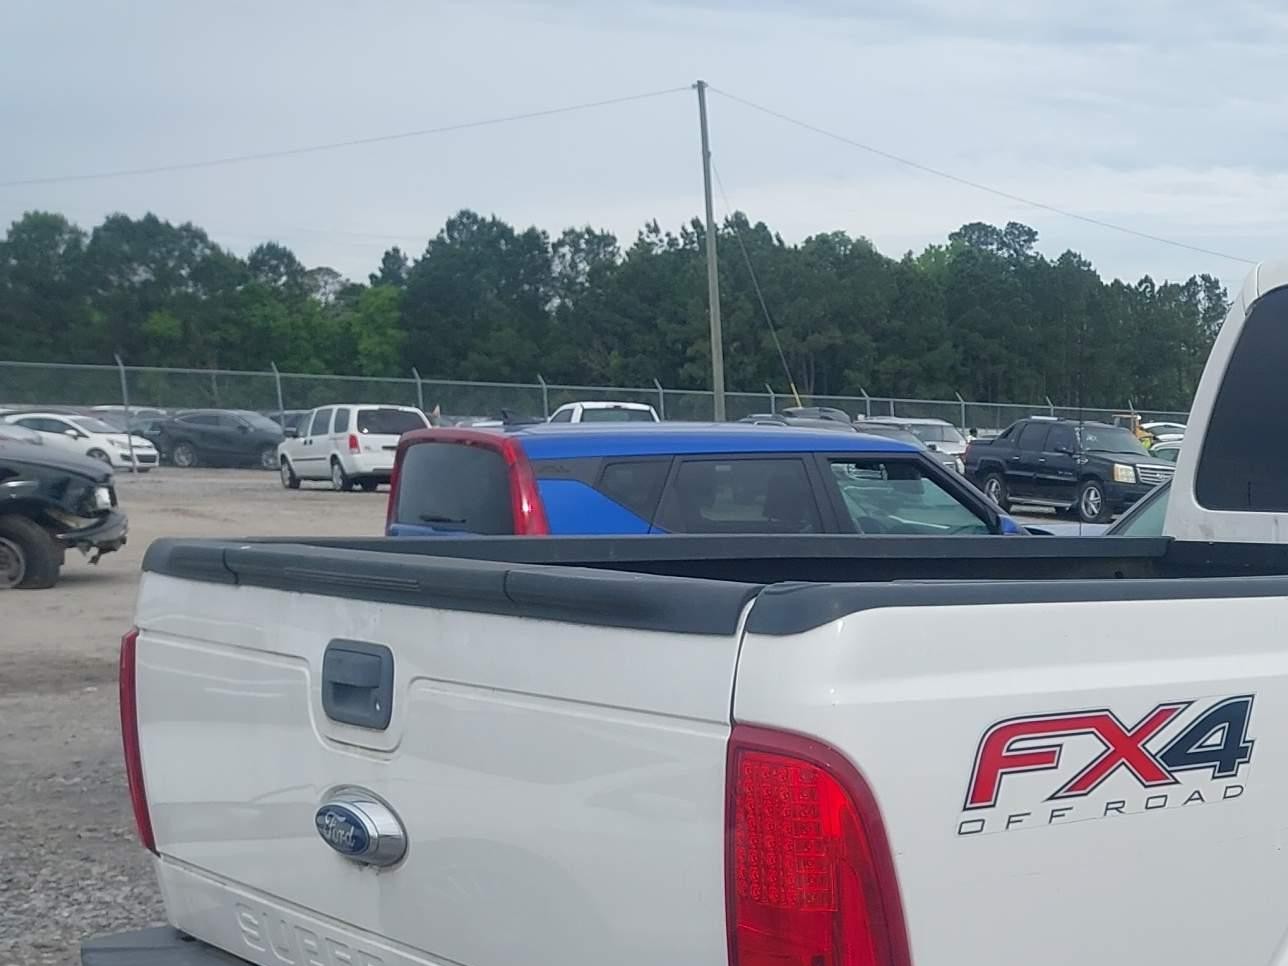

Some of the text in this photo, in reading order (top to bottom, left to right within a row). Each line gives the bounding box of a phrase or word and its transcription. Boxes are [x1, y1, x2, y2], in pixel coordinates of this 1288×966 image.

[962, 694, 1256, 812] FX4
[323, 810, 357, 848] Ford
[957, 784, 1245, 836] OFF ROAD
